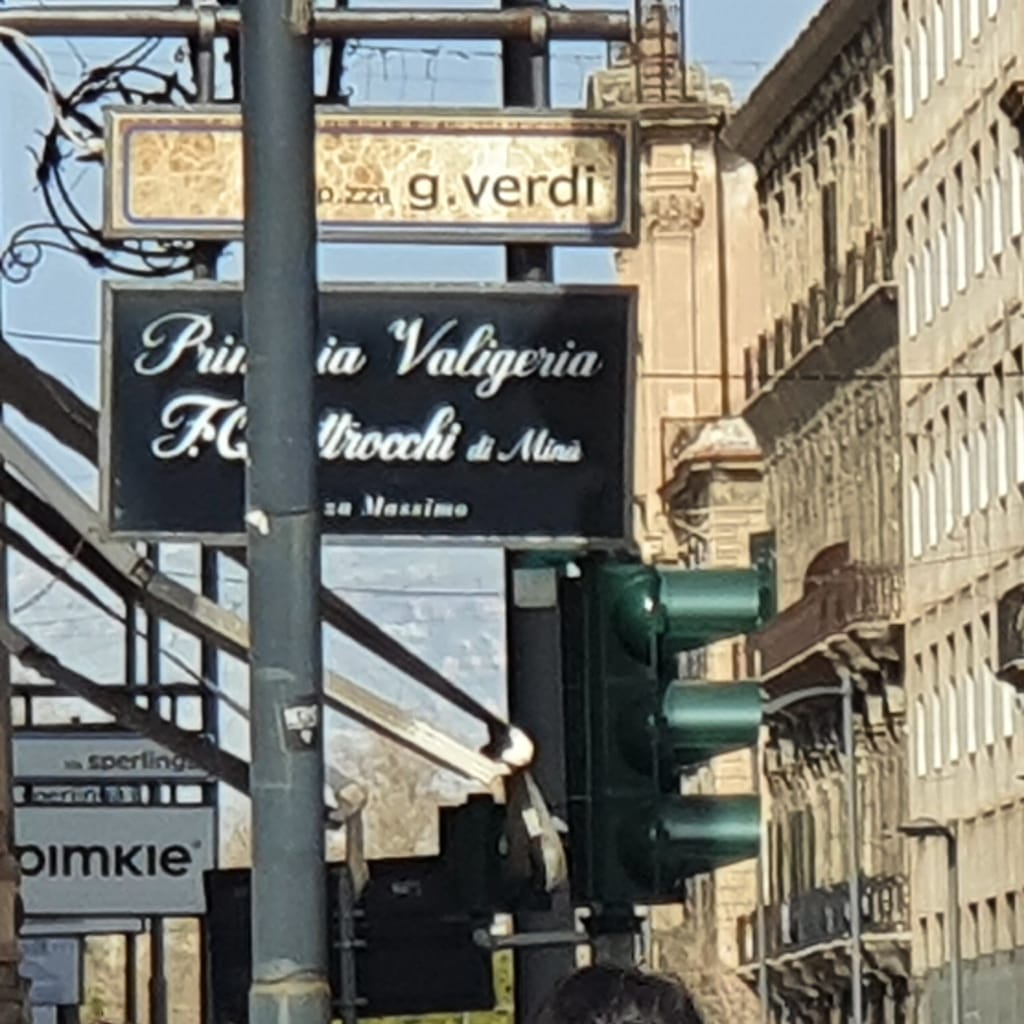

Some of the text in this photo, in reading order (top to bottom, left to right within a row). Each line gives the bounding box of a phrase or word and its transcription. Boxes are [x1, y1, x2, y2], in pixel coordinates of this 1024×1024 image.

[408, 165, 597, 212] g.verdi
[388, 319, 602, 398] Valigeria
[466, 434, 496, 462] di
[361, 494, 469, 518] Massimo
